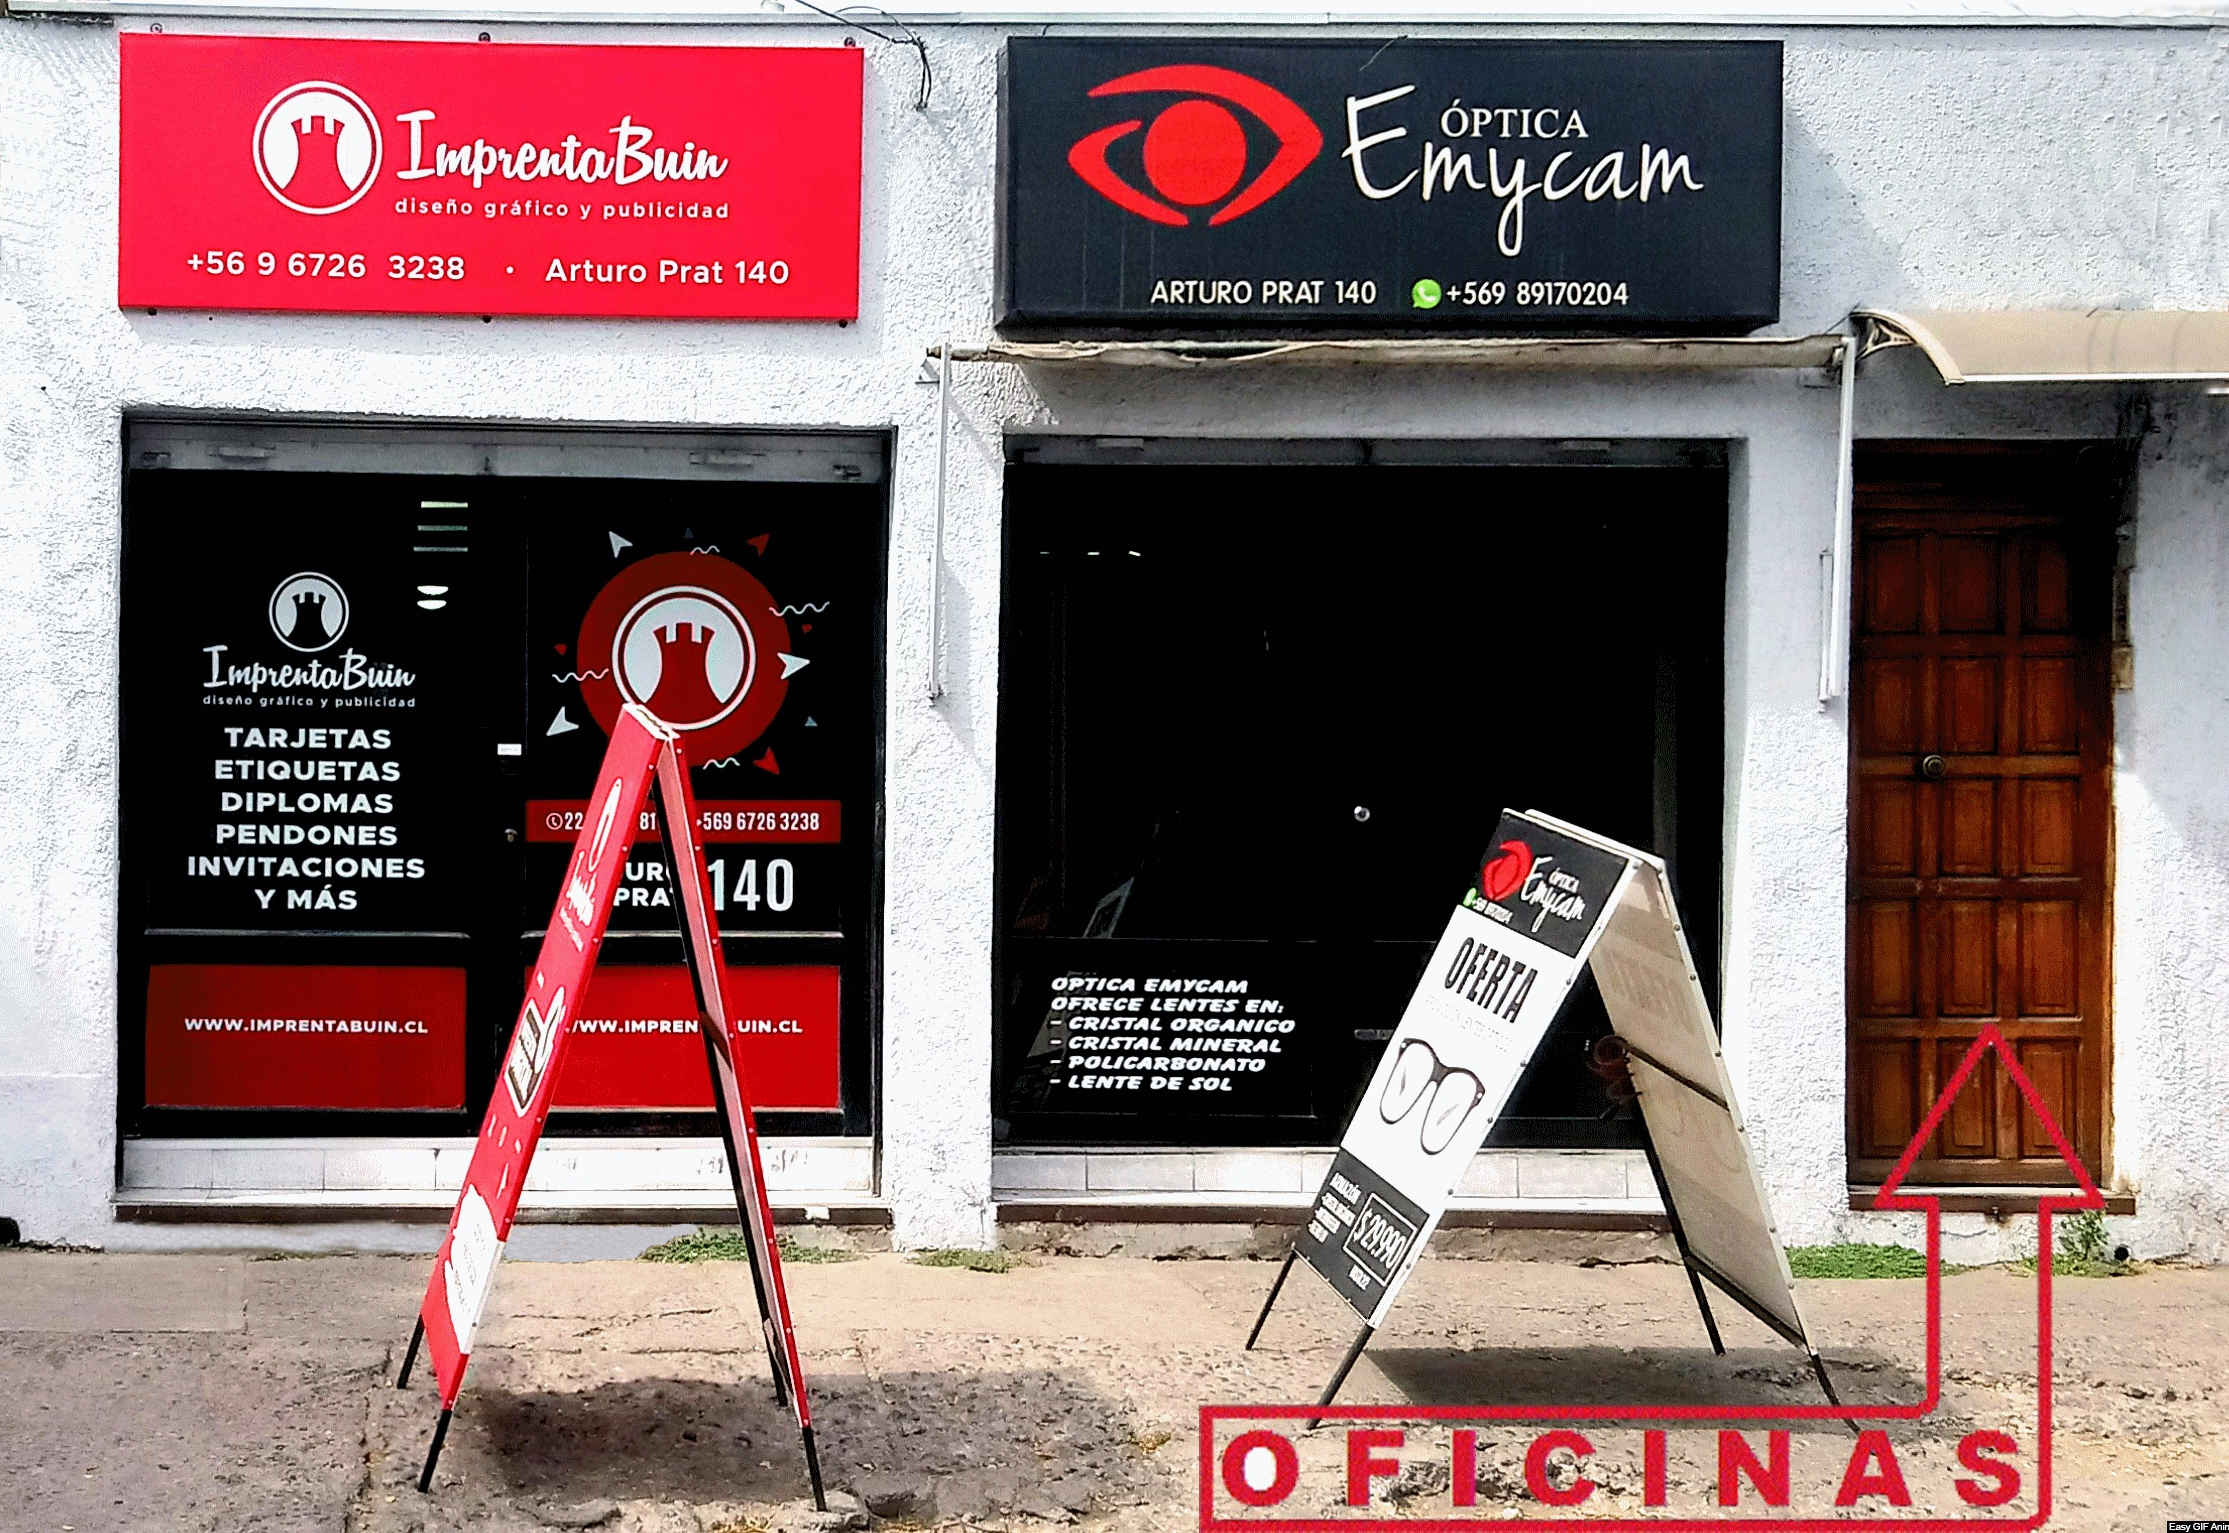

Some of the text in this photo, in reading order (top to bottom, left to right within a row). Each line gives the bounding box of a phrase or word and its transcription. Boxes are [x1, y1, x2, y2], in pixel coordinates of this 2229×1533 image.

[1441, 98, 1589, 139] ÓPTICA
[1341, 84, 1704, 257] Emycam
[395, 197, 728, 220] diseño gráfico y publicidad
[187, 250, 465, 280] +56 9 6726 3238
[545, 258, 789, 284] Arturo Prat 140
[1150, 280, 1377, 304] ARTURO PRAT 140
[1446, 281, 1629, 306] +569 89170204
[202, 694, 416, 709] diseño gráfico y publicidad
[224, 727, 392, 750] TARJETAS
[215, 759, 401, 782] ETIQUETAS
[221, 791, 394, 814] DIPLOMAS
[736, 812, 776, 831] 6726
[779, 812, 820, 831] 3238
[216, 823, 398, 846] PENDONES
[188, 856, 425, 879] INVITACIONES
[254, 883, 358, 910] Y MÁS
[707, 858, 794, 912] 140
[1520, 856, 1586, 933] Emycam
[613, 887, 673, 907] PRA
[1051, 977, 1248, 994] OPTICA EMYCAM
[1445, 937, 1538, 1024] OFERTA
[1051, 996, 1284, 1014] OFRECE LENTES EN:
[184, 1018, 429, 1034] WWW.IMPRENTABUIN.CL
[1068, 1016, 1163, 1031] CRISTAL
[1170, 1017, 1296, 1034] ORGANICO
[1068, 1035, 1162, 1051] CRISTAL
[1169, 1037, 1282, 1054] MINERAL
[1068, 1055, 1266, 1072] POLICARBONATO
[1068, 1075, 1144, 1090] LENTE
[1149, 1076, 1184, 1091] DE
[1188, 1076, 1233, 1092] SOL
